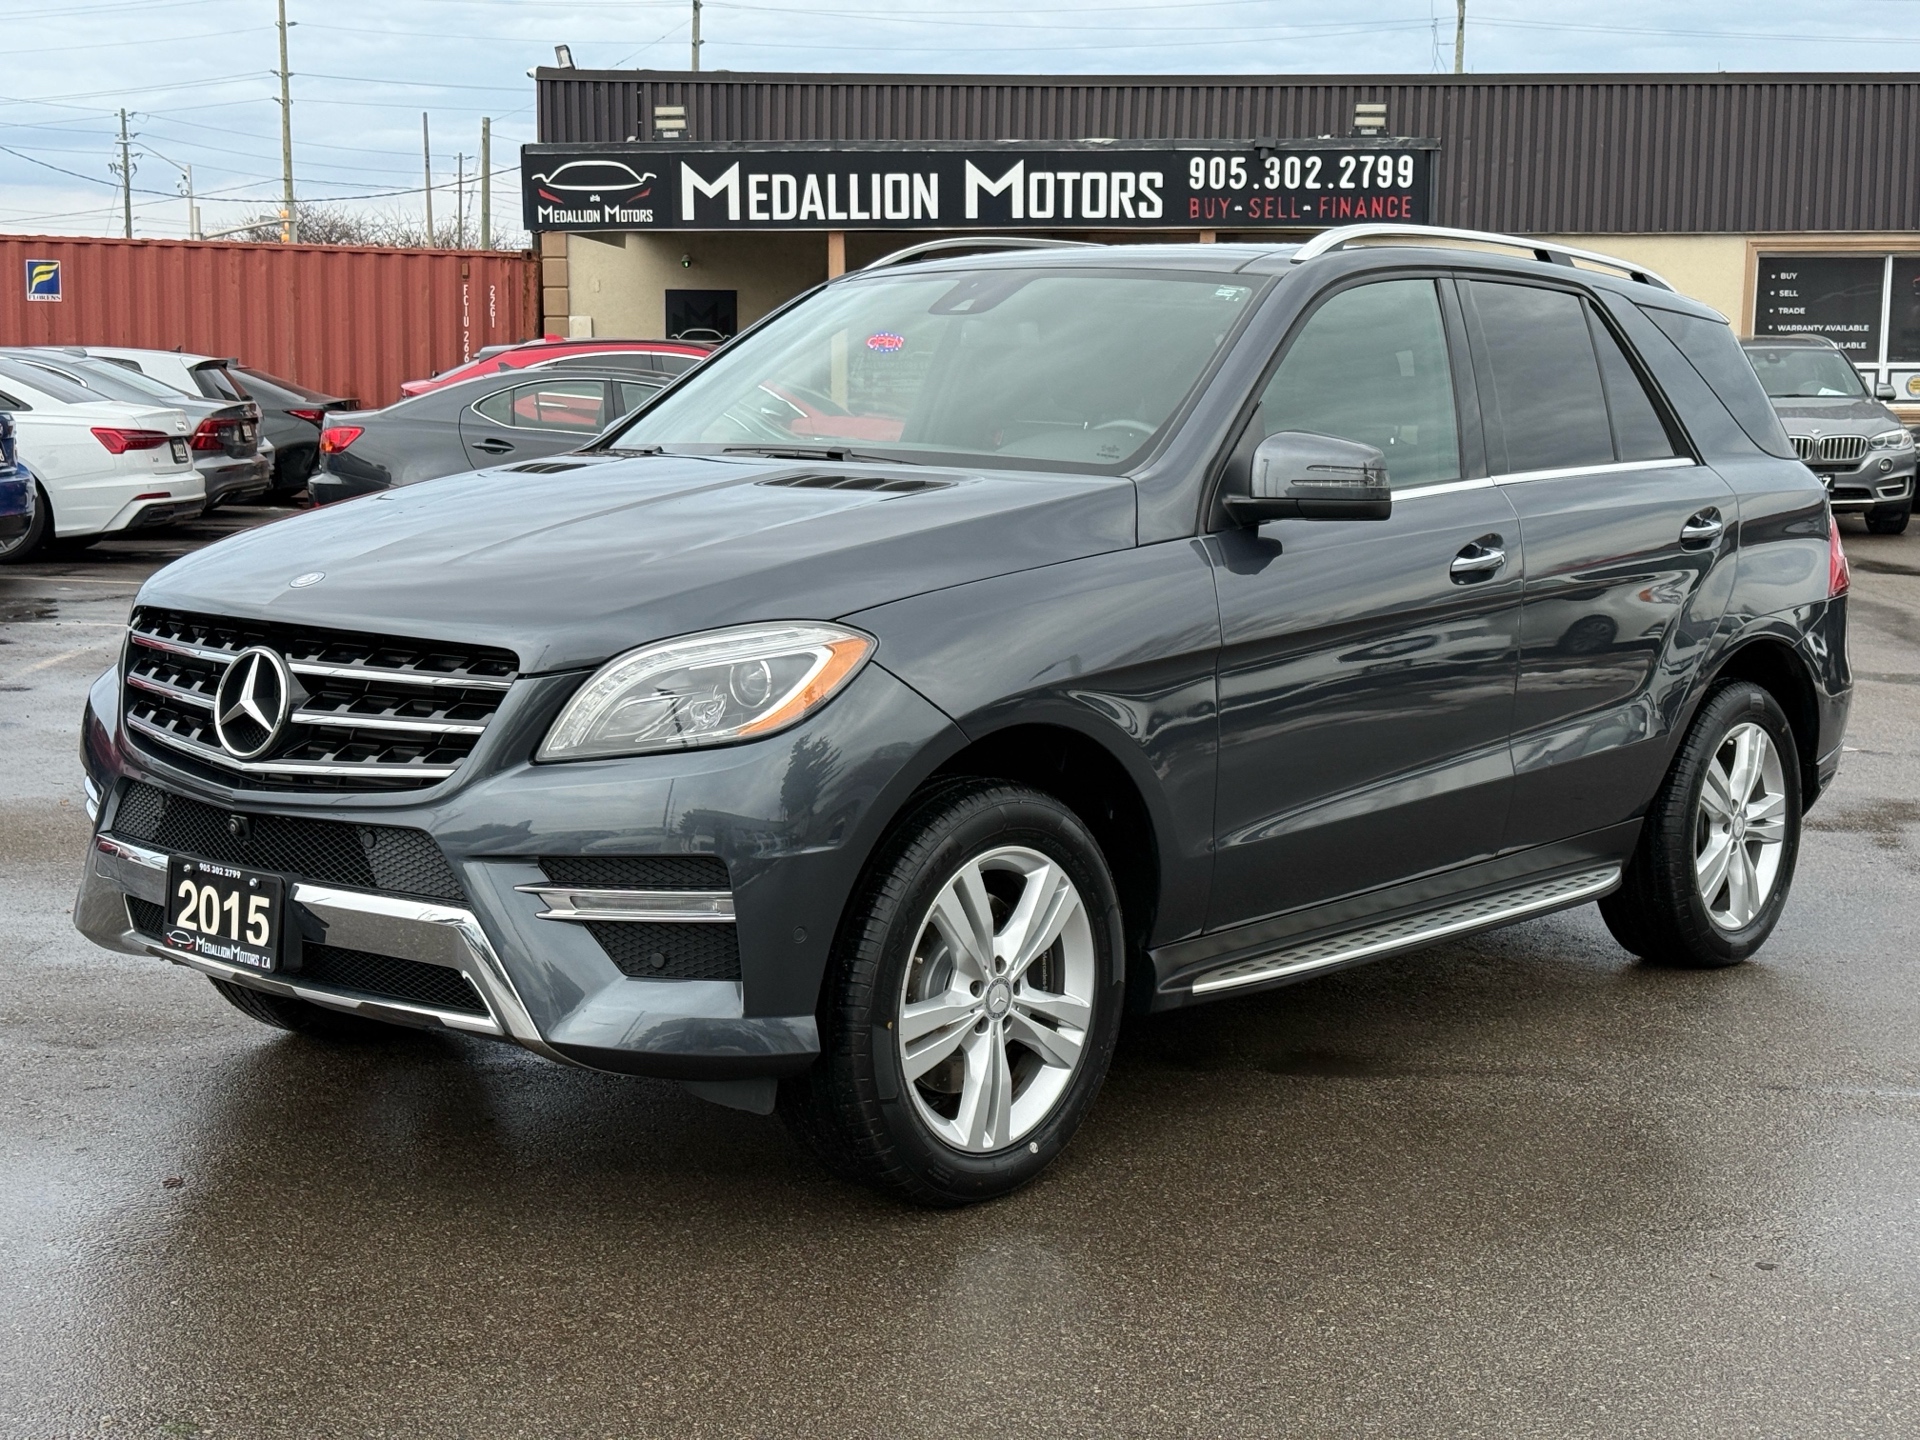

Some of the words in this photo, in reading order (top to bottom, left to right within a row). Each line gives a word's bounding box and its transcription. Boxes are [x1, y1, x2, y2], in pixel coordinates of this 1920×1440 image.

[1189, 155, 1414, 190] 905.302.2799
[681, 161, 939, 221] MEDALLION
[965, 159, 1163, 219] MOTORS
[538, 205, 600, 223] MEDALLION
[604, 204, 653, 223] MOTORS
[1189, 197, 1231, 219] BUY
[1248, 196, 1301, 219] SELL
[1318, 196, 1412, 219] FINANCE
[1780, 272, 1798, 280] BUY
[1777, 324, 1824, 332] WARRANTY
[1825, 324, 1870, 332] AVAILABLE
[867, 336, 904, 349] OPEN
[199, 863, 210, 872] 905
[212, 865, 223, 875] 302
[225, 869, 241, 879] 2799
[177, 880, 270, 947] 2015
